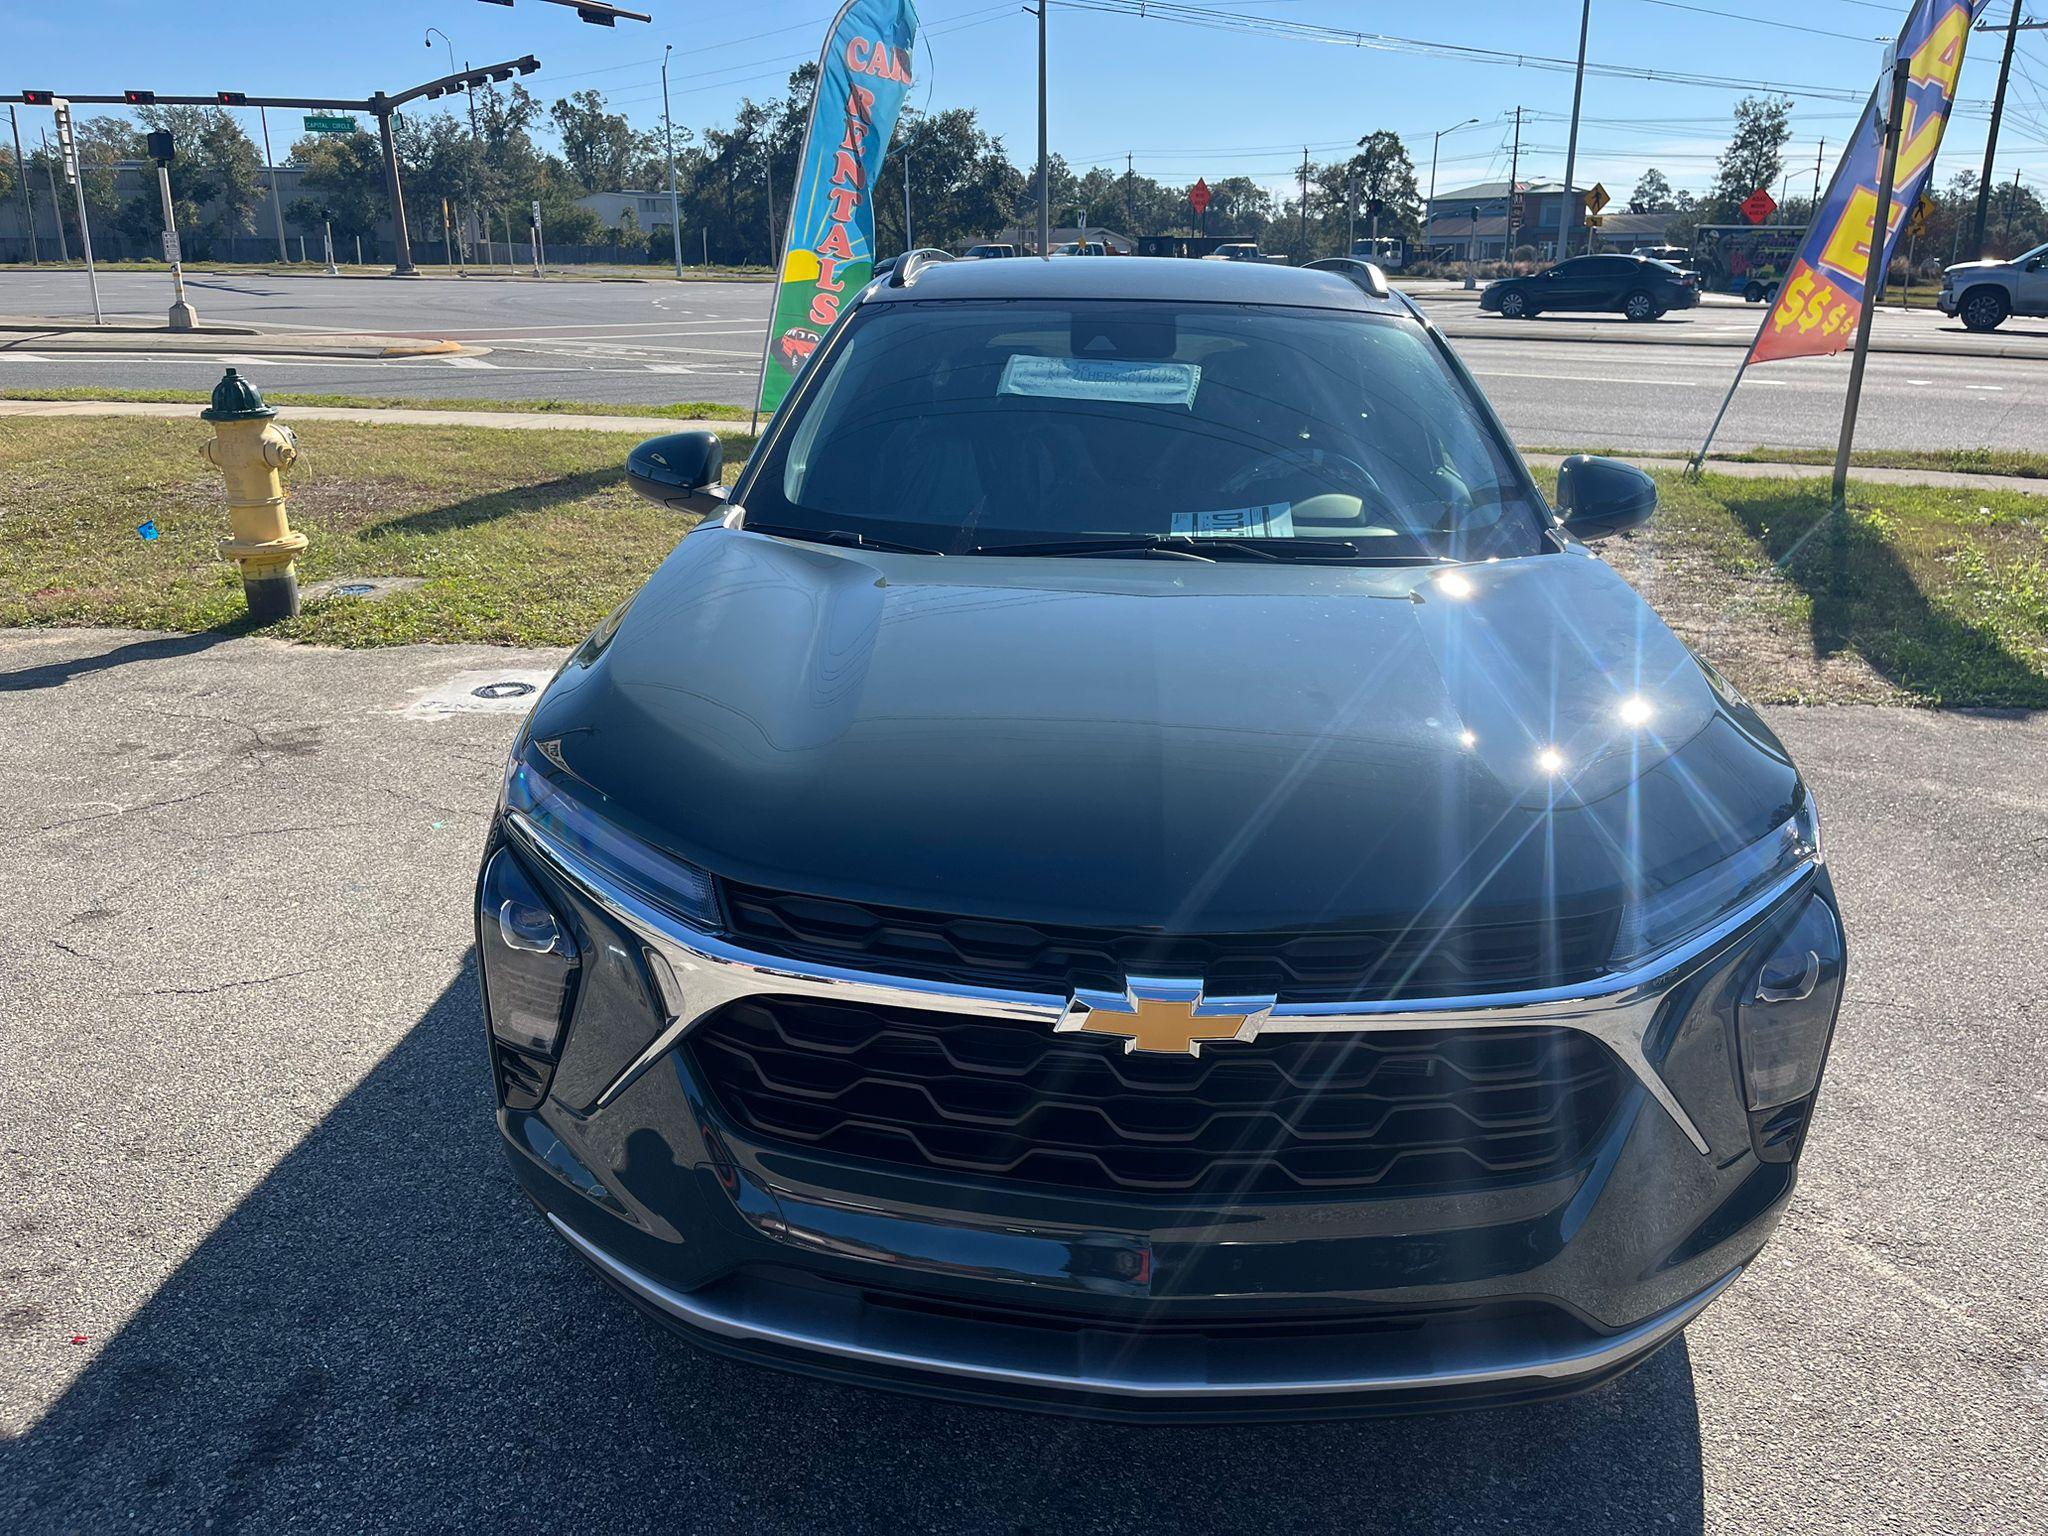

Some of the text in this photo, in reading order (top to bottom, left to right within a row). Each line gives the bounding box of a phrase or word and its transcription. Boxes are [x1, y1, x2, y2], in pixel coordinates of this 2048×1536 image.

[847, 36, 912, 84] CAR
[1819, 0, 1972, 284] AVE
[808, 86, 875, 326] RENTALS
